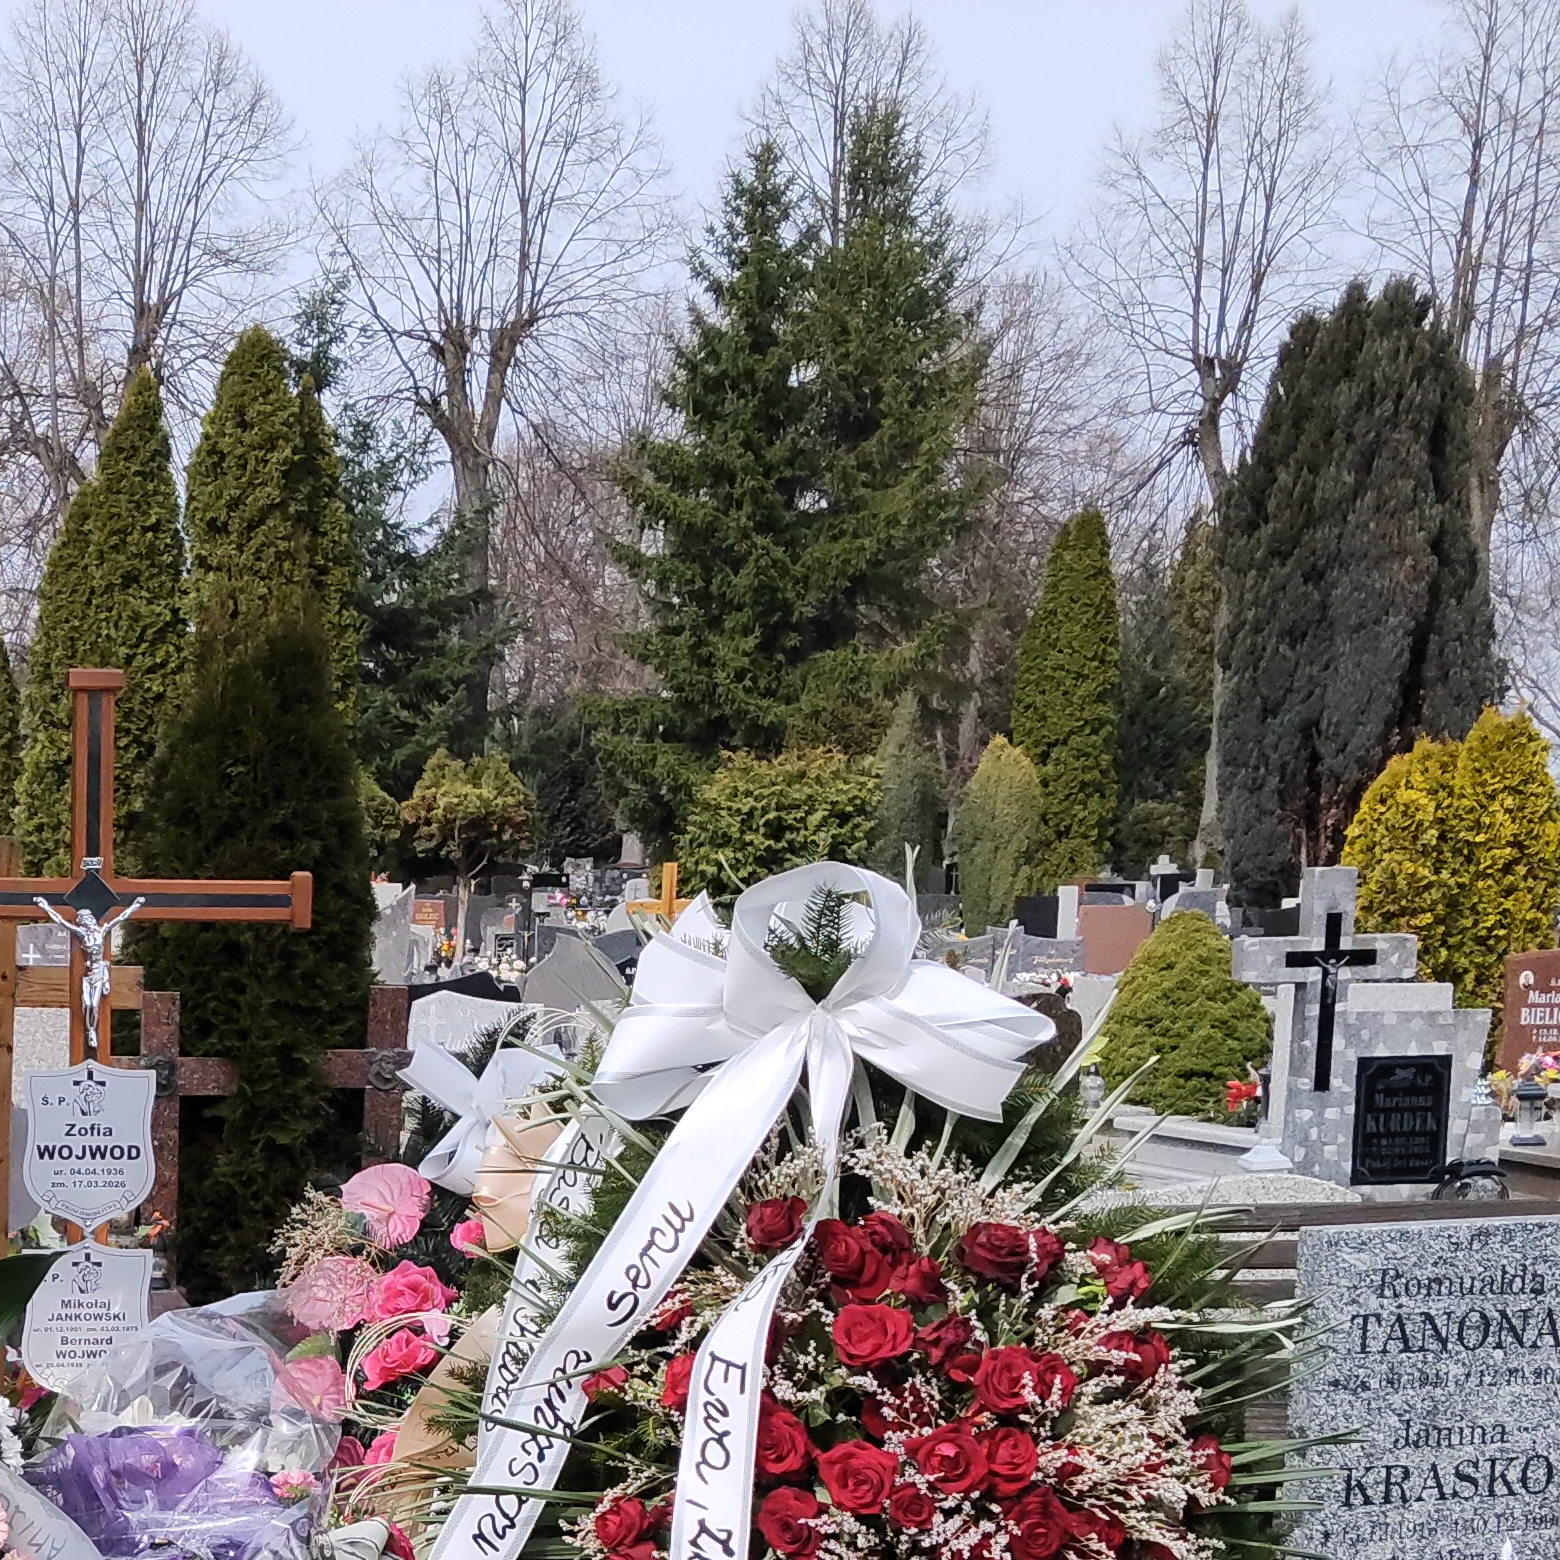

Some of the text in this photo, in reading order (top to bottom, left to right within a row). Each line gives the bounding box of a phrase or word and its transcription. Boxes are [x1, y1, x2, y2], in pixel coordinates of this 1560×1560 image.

[1520, 1007, 1560, 1025] BIELI
[57, 1096, 70, 1107] P.
[64, 1122, 113, 1137] Zofia
[36, 1144, 141, 1161] WOJWOD
[69, 1167, 125, 1176] 04.04.1936
[71, 1180, 127, 1188] 17.03.2026
[1377, 1262, 1547, 1301] Romualda
[60, 1299, 112, 1311] Mikołaj
[47, 1312, 127, 1322] JANKOWSKI
[60, 1336, 113, 1346] Bernard
[1392, 1418, 1510, 1451] Janina
